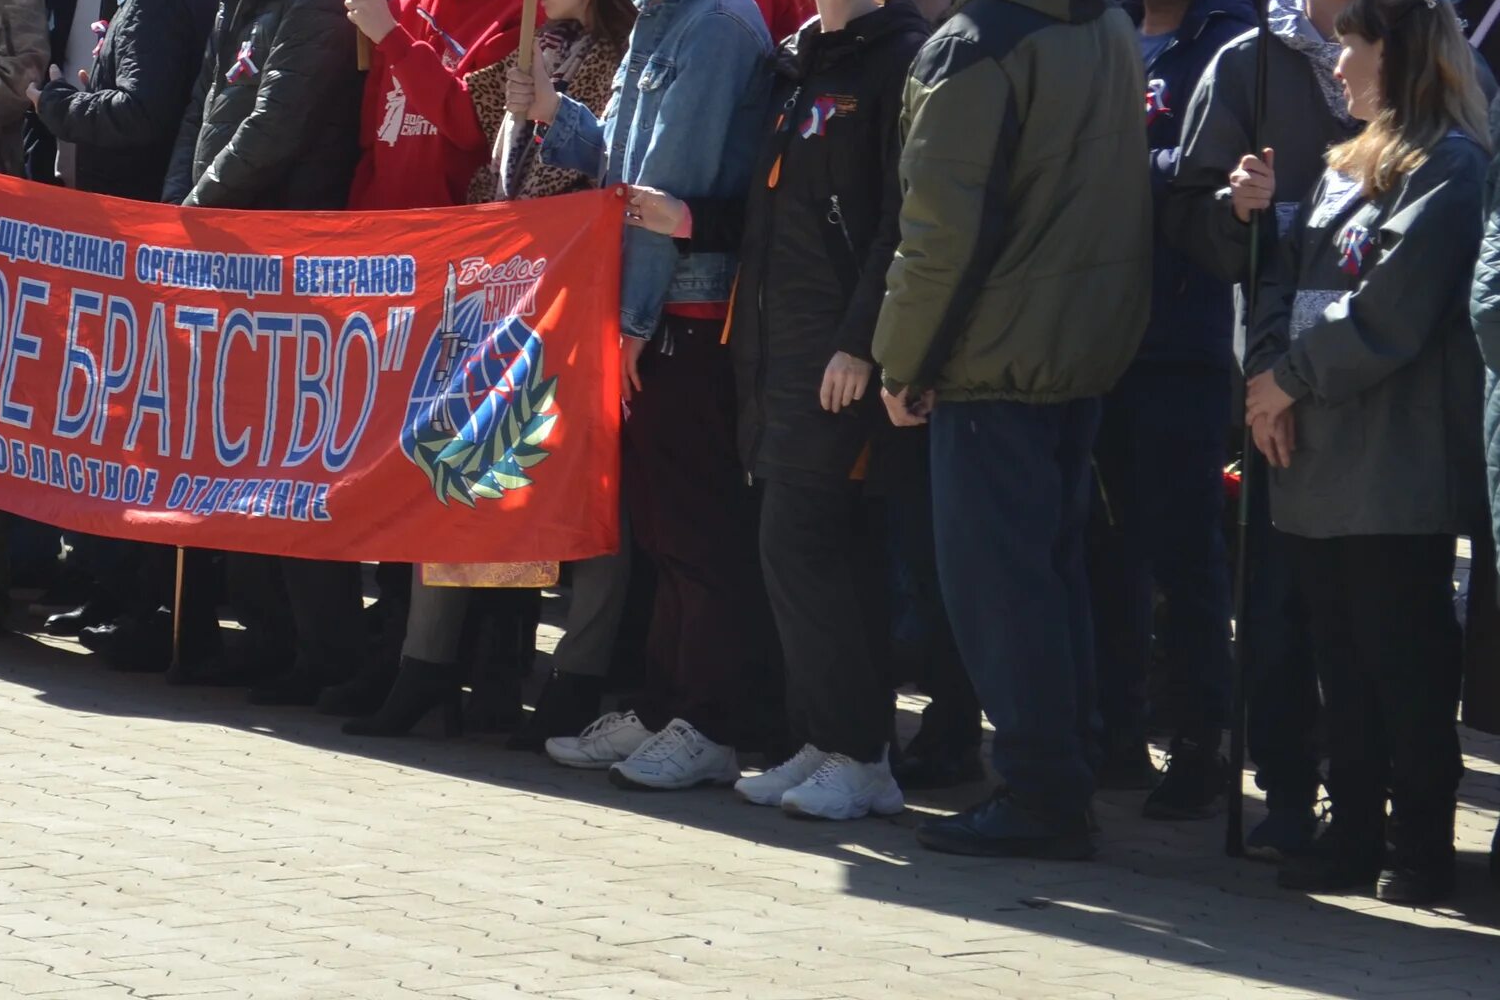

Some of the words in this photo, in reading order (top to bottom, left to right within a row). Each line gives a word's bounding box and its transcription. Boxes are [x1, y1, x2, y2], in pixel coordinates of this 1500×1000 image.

[136, 243, 283, 297] ОРГАНИЗАЦИЯ
[293, 254, 416, 298] ВЕТЕРАНОВ
[457, 254, 547, 286] Боевое
[52, 288, 416, 473] БРАТСТВО"
[166, 472, 332, 523] ОТДЕЛЕНИЕ
